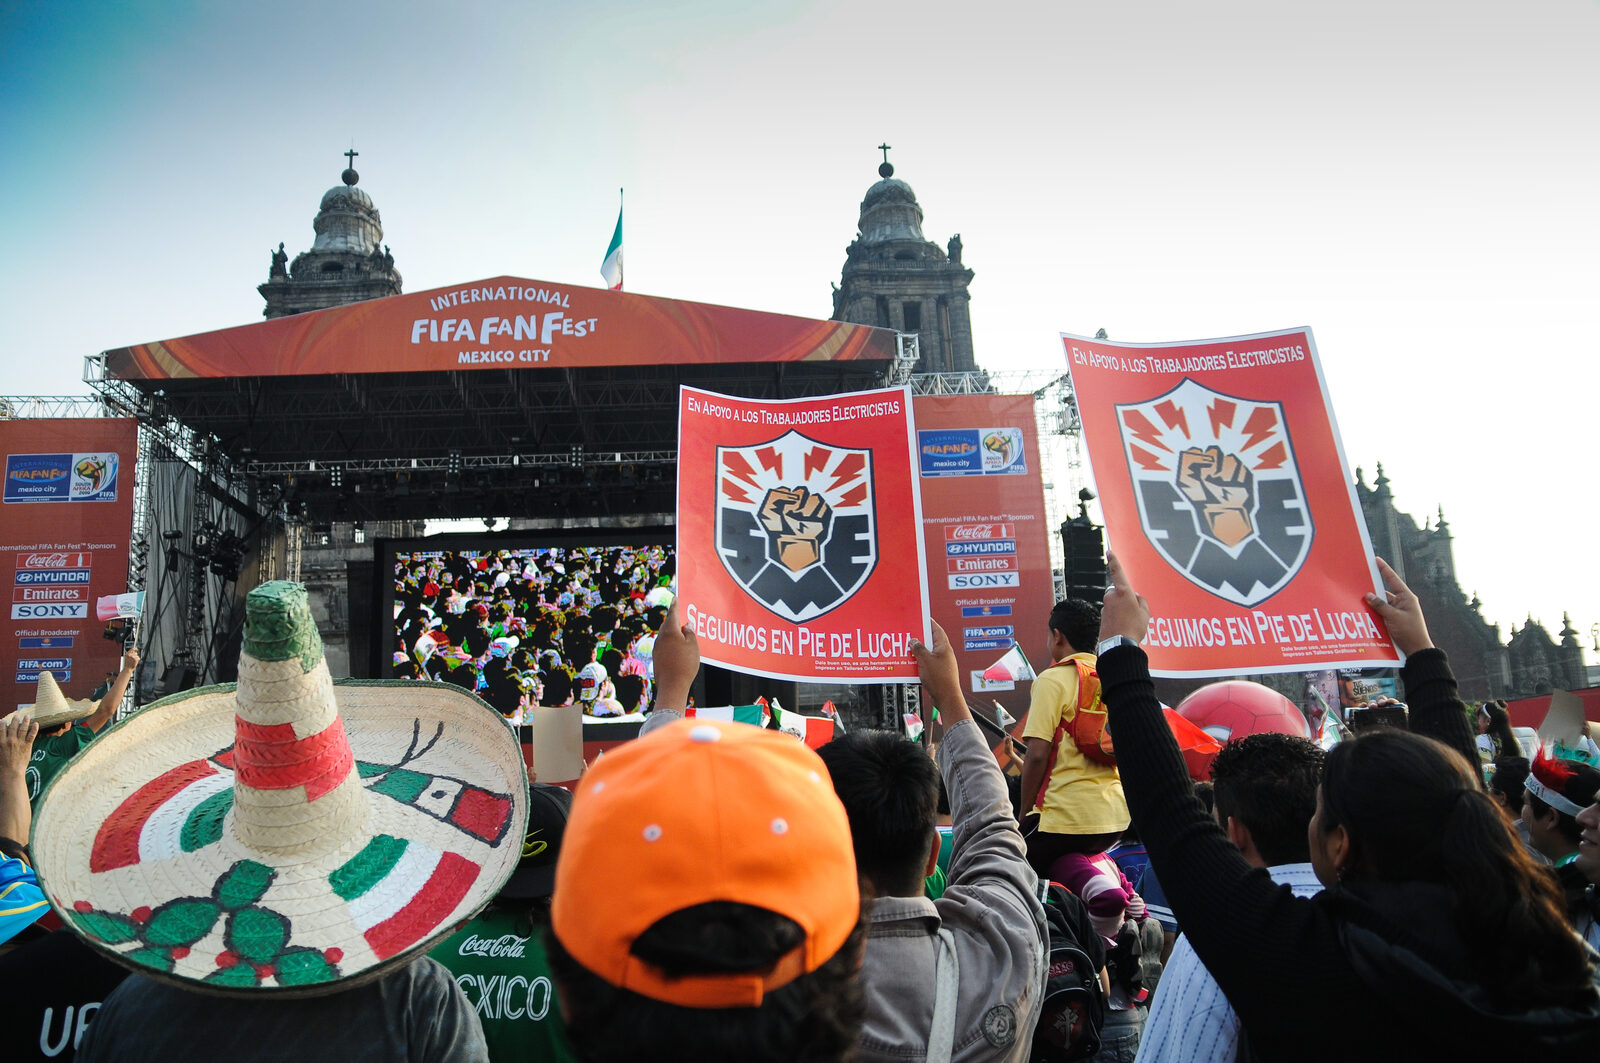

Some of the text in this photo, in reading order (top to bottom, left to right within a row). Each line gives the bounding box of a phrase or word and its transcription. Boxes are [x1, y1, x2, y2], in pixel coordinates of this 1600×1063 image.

[430, 286, 570, 311] INTERNATIONAL
[411, 312, 598, 345] FIFA FAN FEST
[457, 349, 551, 364] MEXICO CITY
[1121, 357, 1129, 372] A
[1128, 358, 1148, 373] LOS
[1146, 354, 1227, 374] TRABAJADORES
[1226, 345, 1305, 369] ELECTRICISTAS
[733, 409, 740, 421] A
[741, 410, 759, 423] LOS
[760, 409, 831, 425] TRABAJADORES
[832, 401, 900, 421] ELECTRICISTAS
[958, 459, 970, 467] city
[10, 470, 30, 479] FIFA
[18, 485, 57, 493] mexico city
[923, 516, 963, 524] nternational
[1007, 514, 1035, 522] Sponsors
[87, 543, 117, 551] Sponsors
[964, 542, 1015, 553] HYUNDAI
[956, 558, 1009, 571] Emirates
[34, 572, 89, 582] HYUNDAI
[955, 574, 1014, 587] SONY
[23, 587, 79, 600] Emirates
[956, 597, 1017, 606] Official Broadcaster
[18, 605, 82, 617] SONY
[14, 629, 39, 637] Official
[686, 603, 767, 652] SEGUIMOS
[771, 629, 794, 656] EN
[798, 627, 827, 658] PIE
[830, 633, 854, 659] DE
[965, 627, 1006, 637] FIFA.com
[1224, 617, 1256, 646] EN
[1252, 610, 1291, 645] PIE
[1288, 613, 1319, 643] DE
[1313, 608, 1383, 641] LUCHA
[18, 659, 63, 669] FIFA.com
[458, 933, 531, 958] Coca-Cola
